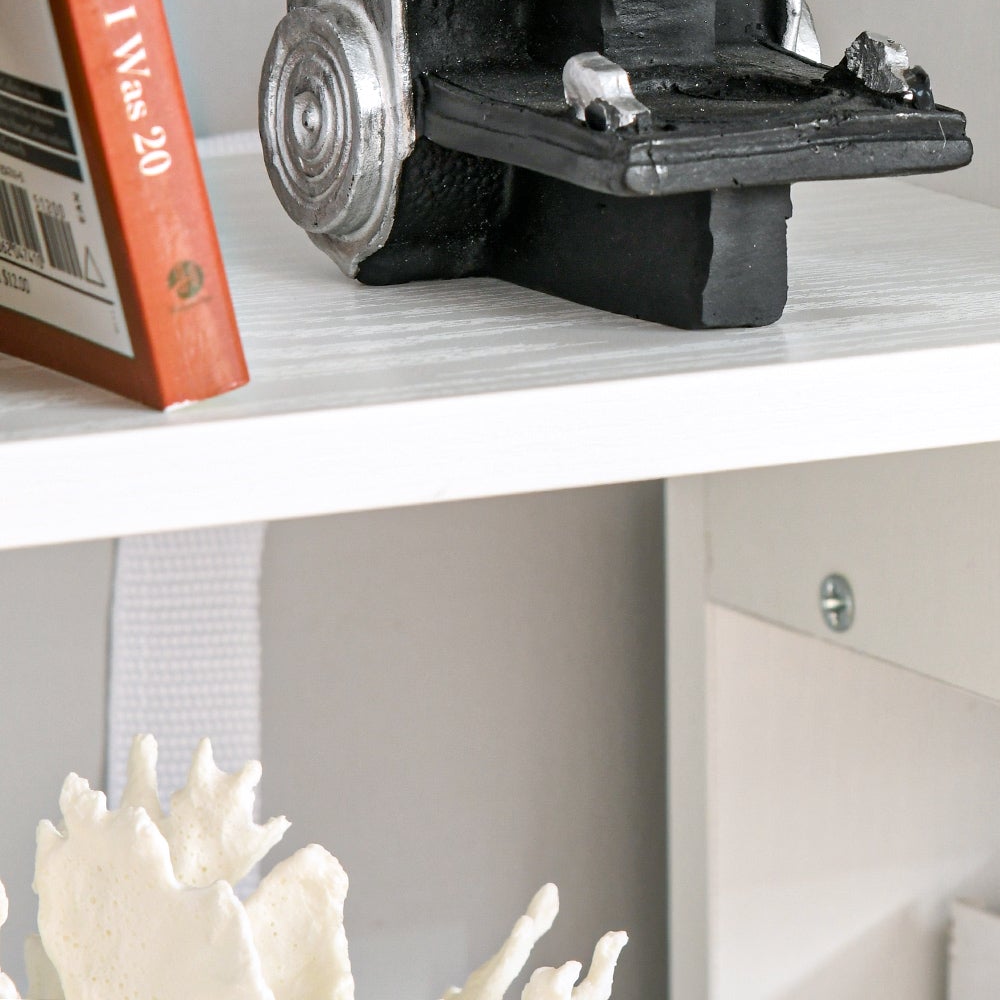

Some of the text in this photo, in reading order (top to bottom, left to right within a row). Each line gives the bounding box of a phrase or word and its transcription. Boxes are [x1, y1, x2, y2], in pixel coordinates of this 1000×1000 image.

[103, 4, 137, 29] I
[112, 31, 151, 121] Was
[132, 125, 172, 177] 20
